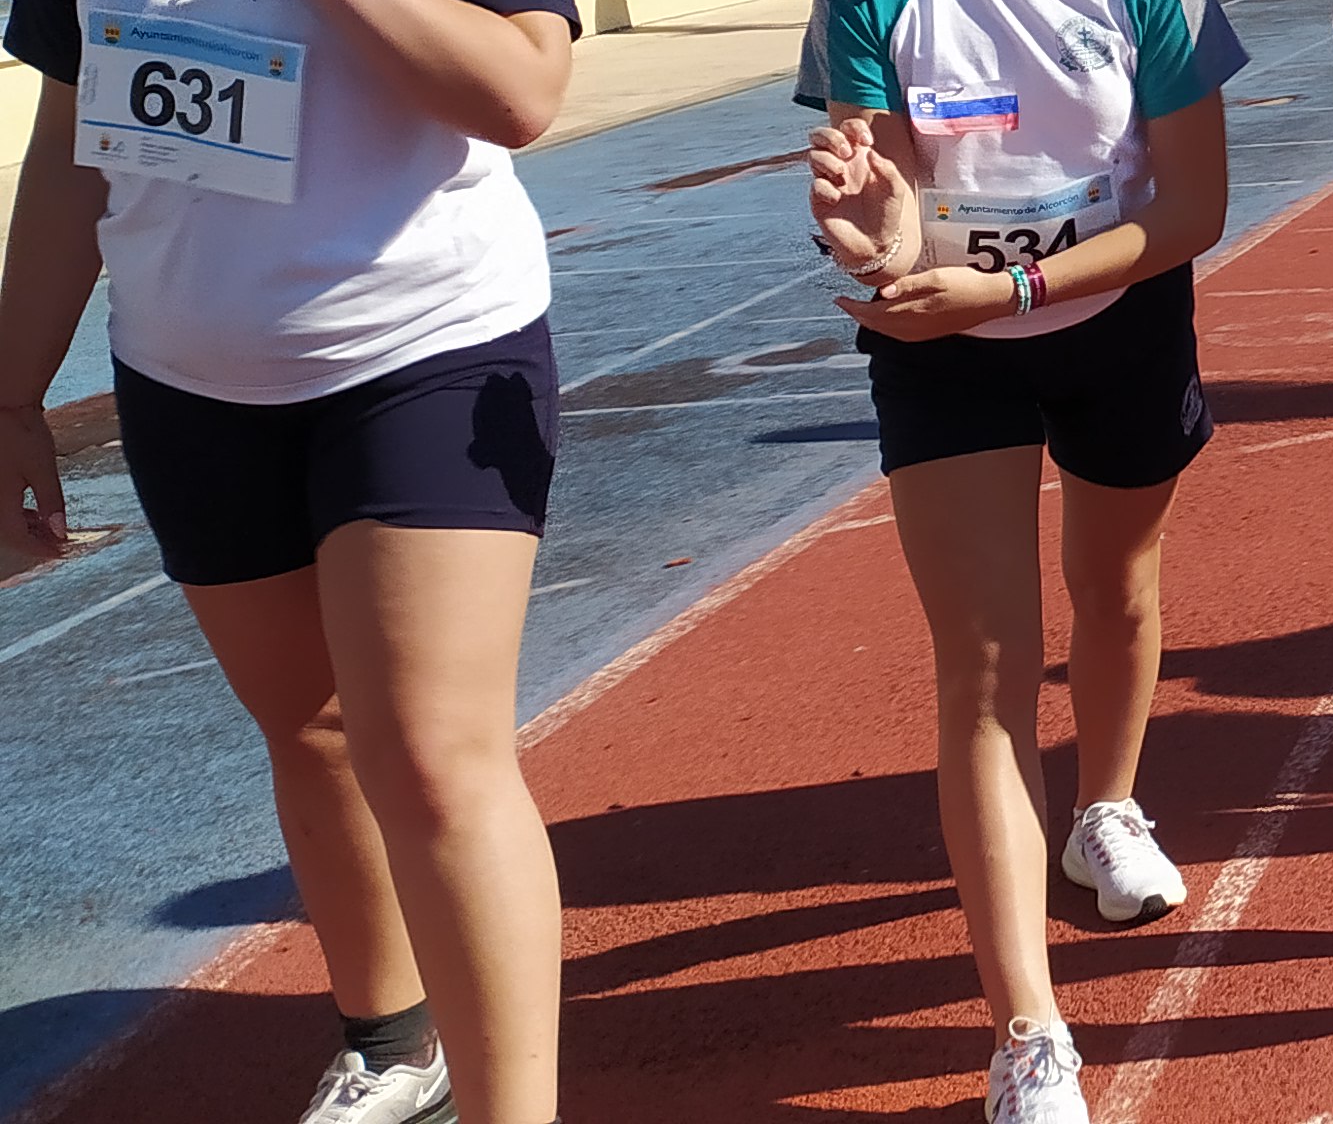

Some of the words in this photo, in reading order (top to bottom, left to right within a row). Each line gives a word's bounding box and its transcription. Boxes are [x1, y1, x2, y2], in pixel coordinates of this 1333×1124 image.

[129, 60, 245, 144] 631
[958, 203, 1023, 215] Ayuntamiento
[1024, 206, 1036, 214] de
